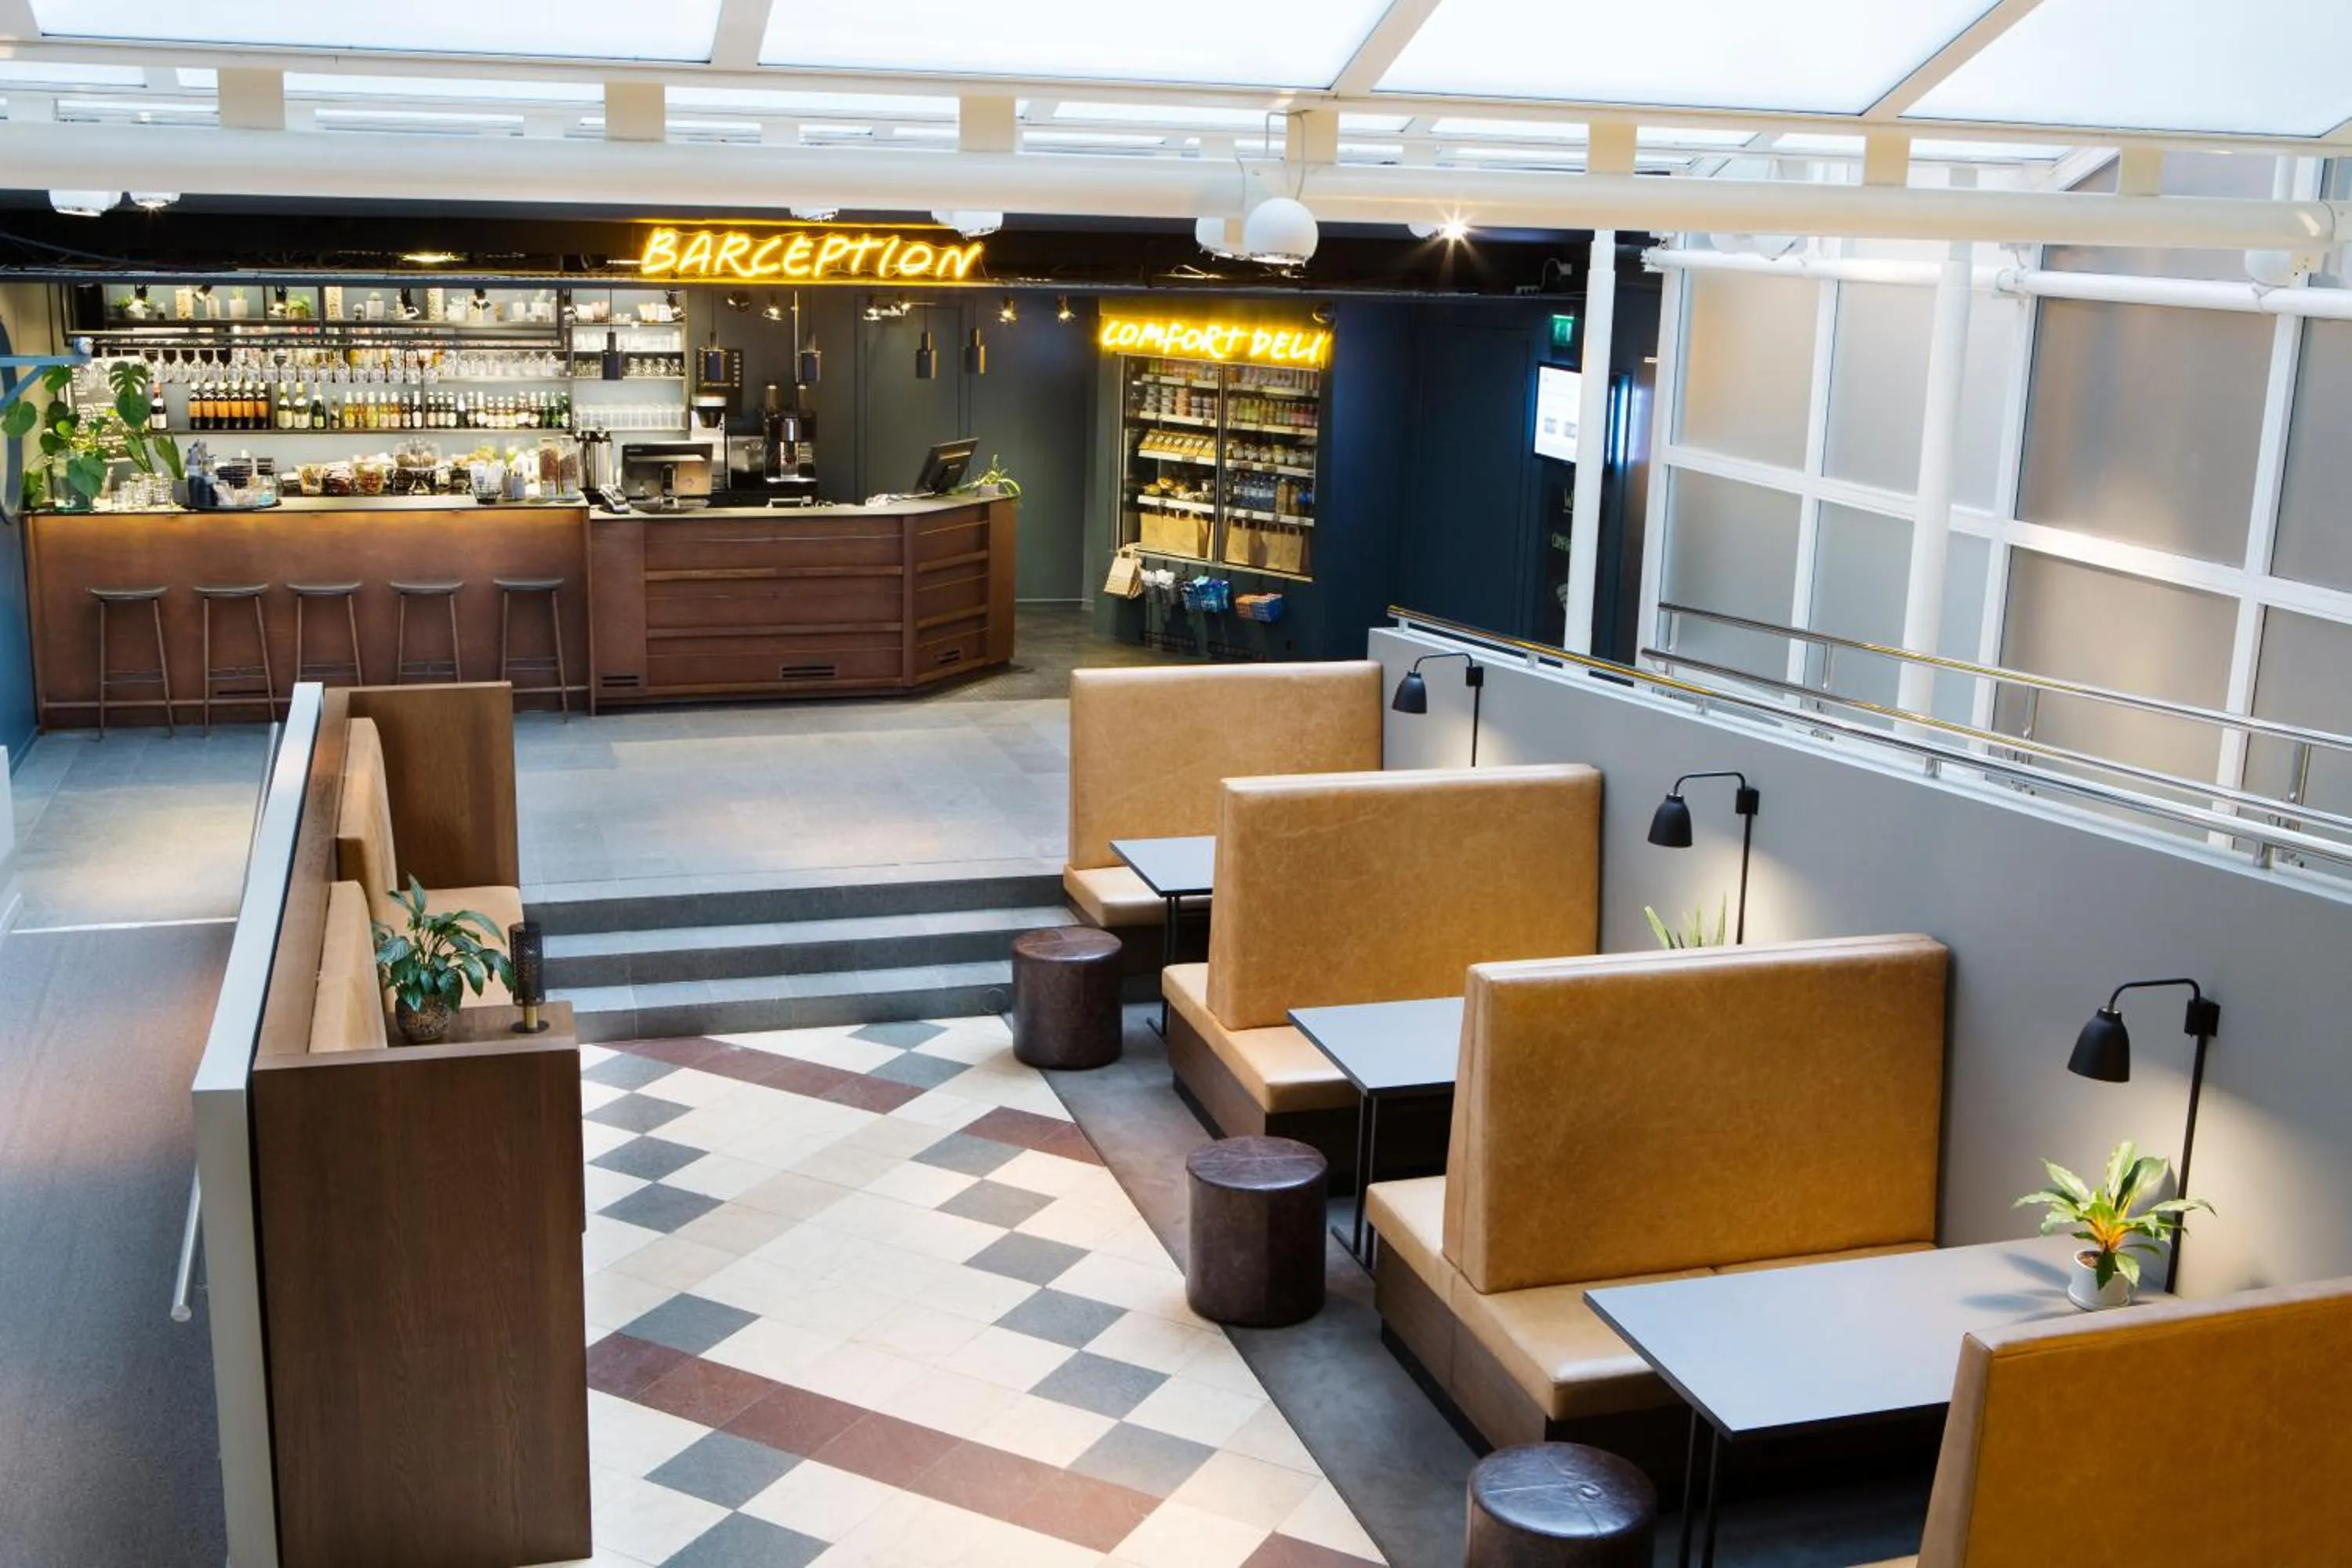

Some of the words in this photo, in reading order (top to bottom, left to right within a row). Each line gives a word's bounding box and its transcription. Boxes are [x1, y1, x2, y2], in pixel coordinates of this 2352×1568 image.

[641, 227, 984, 278] BARCEPTION
[1102, 320, 1247, 359] COMFORT
[1249, 326, 1325, 364] DELI
